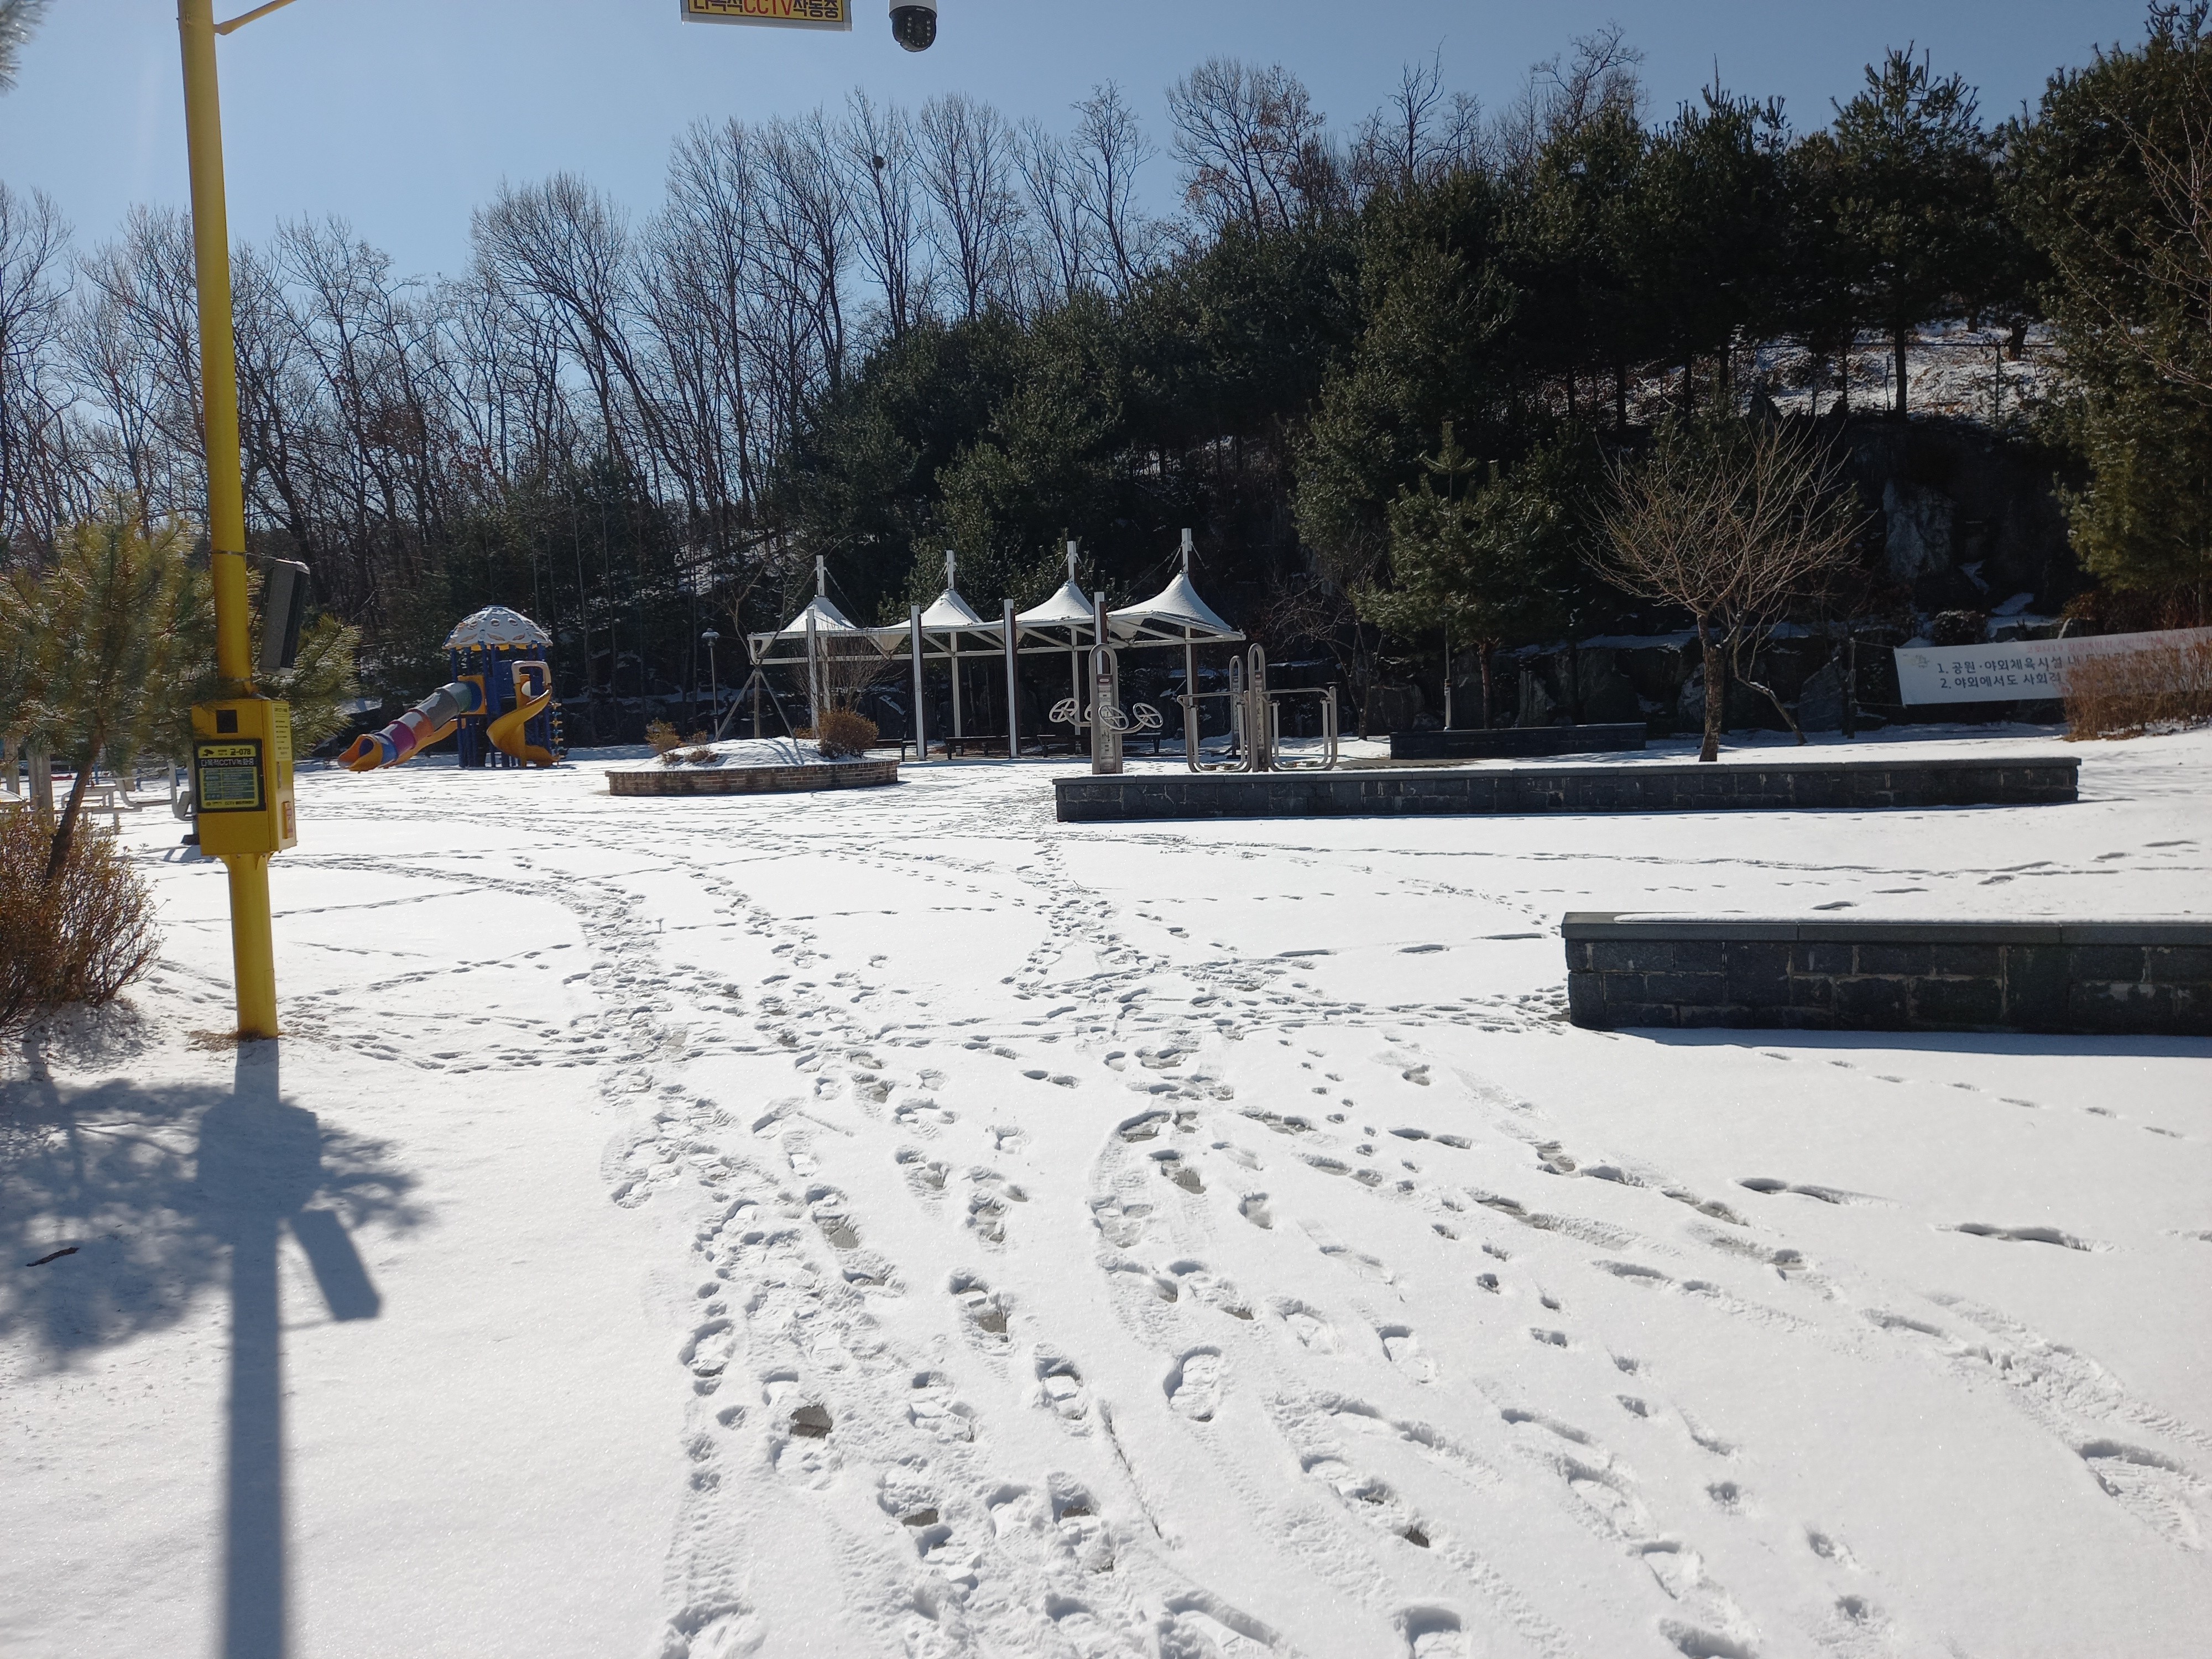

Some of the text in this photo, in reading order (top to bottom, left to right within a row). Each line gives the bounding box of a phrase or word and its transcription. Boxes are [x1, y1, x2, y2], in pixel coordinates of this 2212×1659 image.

[1938, 663, 1949, 674] 1.
[1940, 678, 1952, 689] 2.
[1954, 675, 2018, 688] 야외에서도
